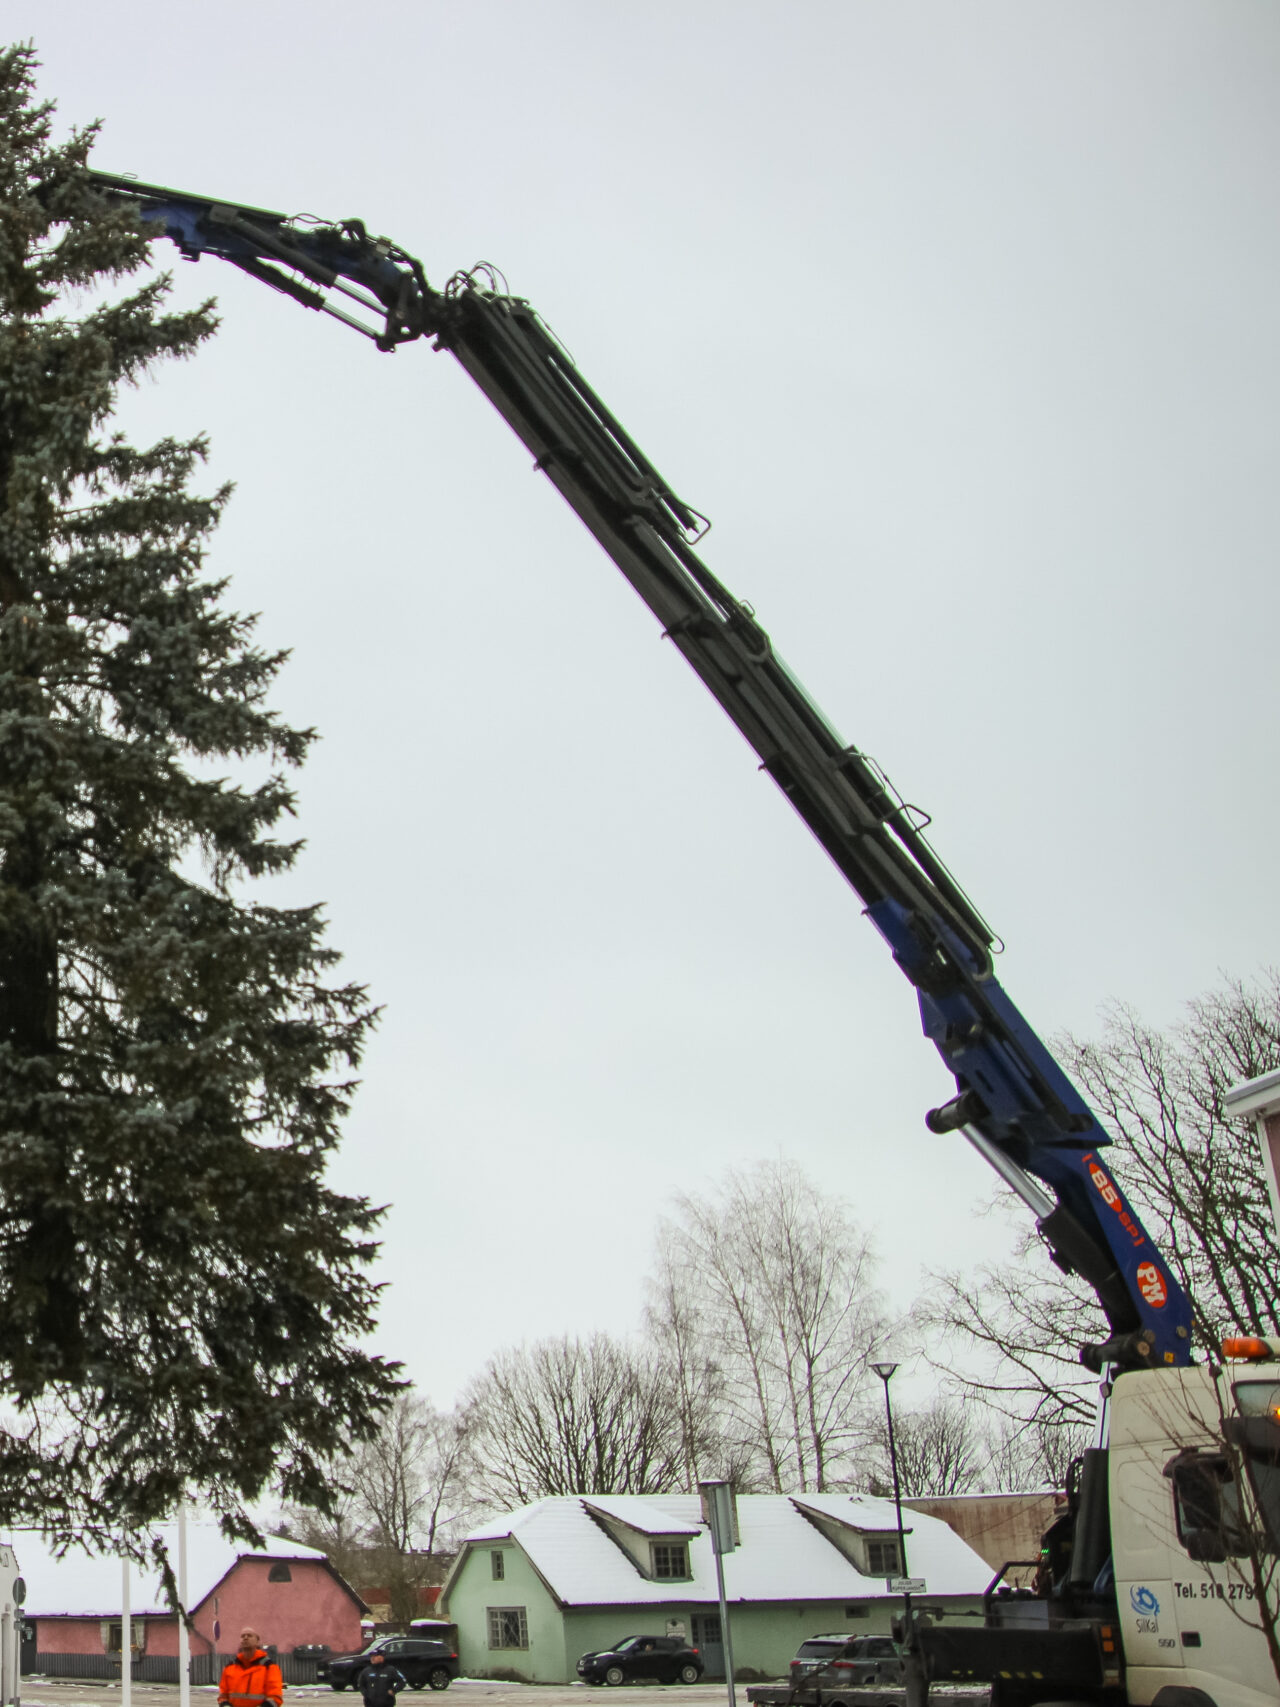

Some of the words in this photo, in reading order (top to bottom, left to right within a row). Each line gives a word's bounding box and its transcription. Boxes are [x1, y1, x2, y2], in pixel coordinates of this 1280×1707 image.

[1091, 1169, 1118, 1205] 85
[1136, 1265, 1166, 1304] PM
[1174, 1582, 1197, 1598] Tel.
